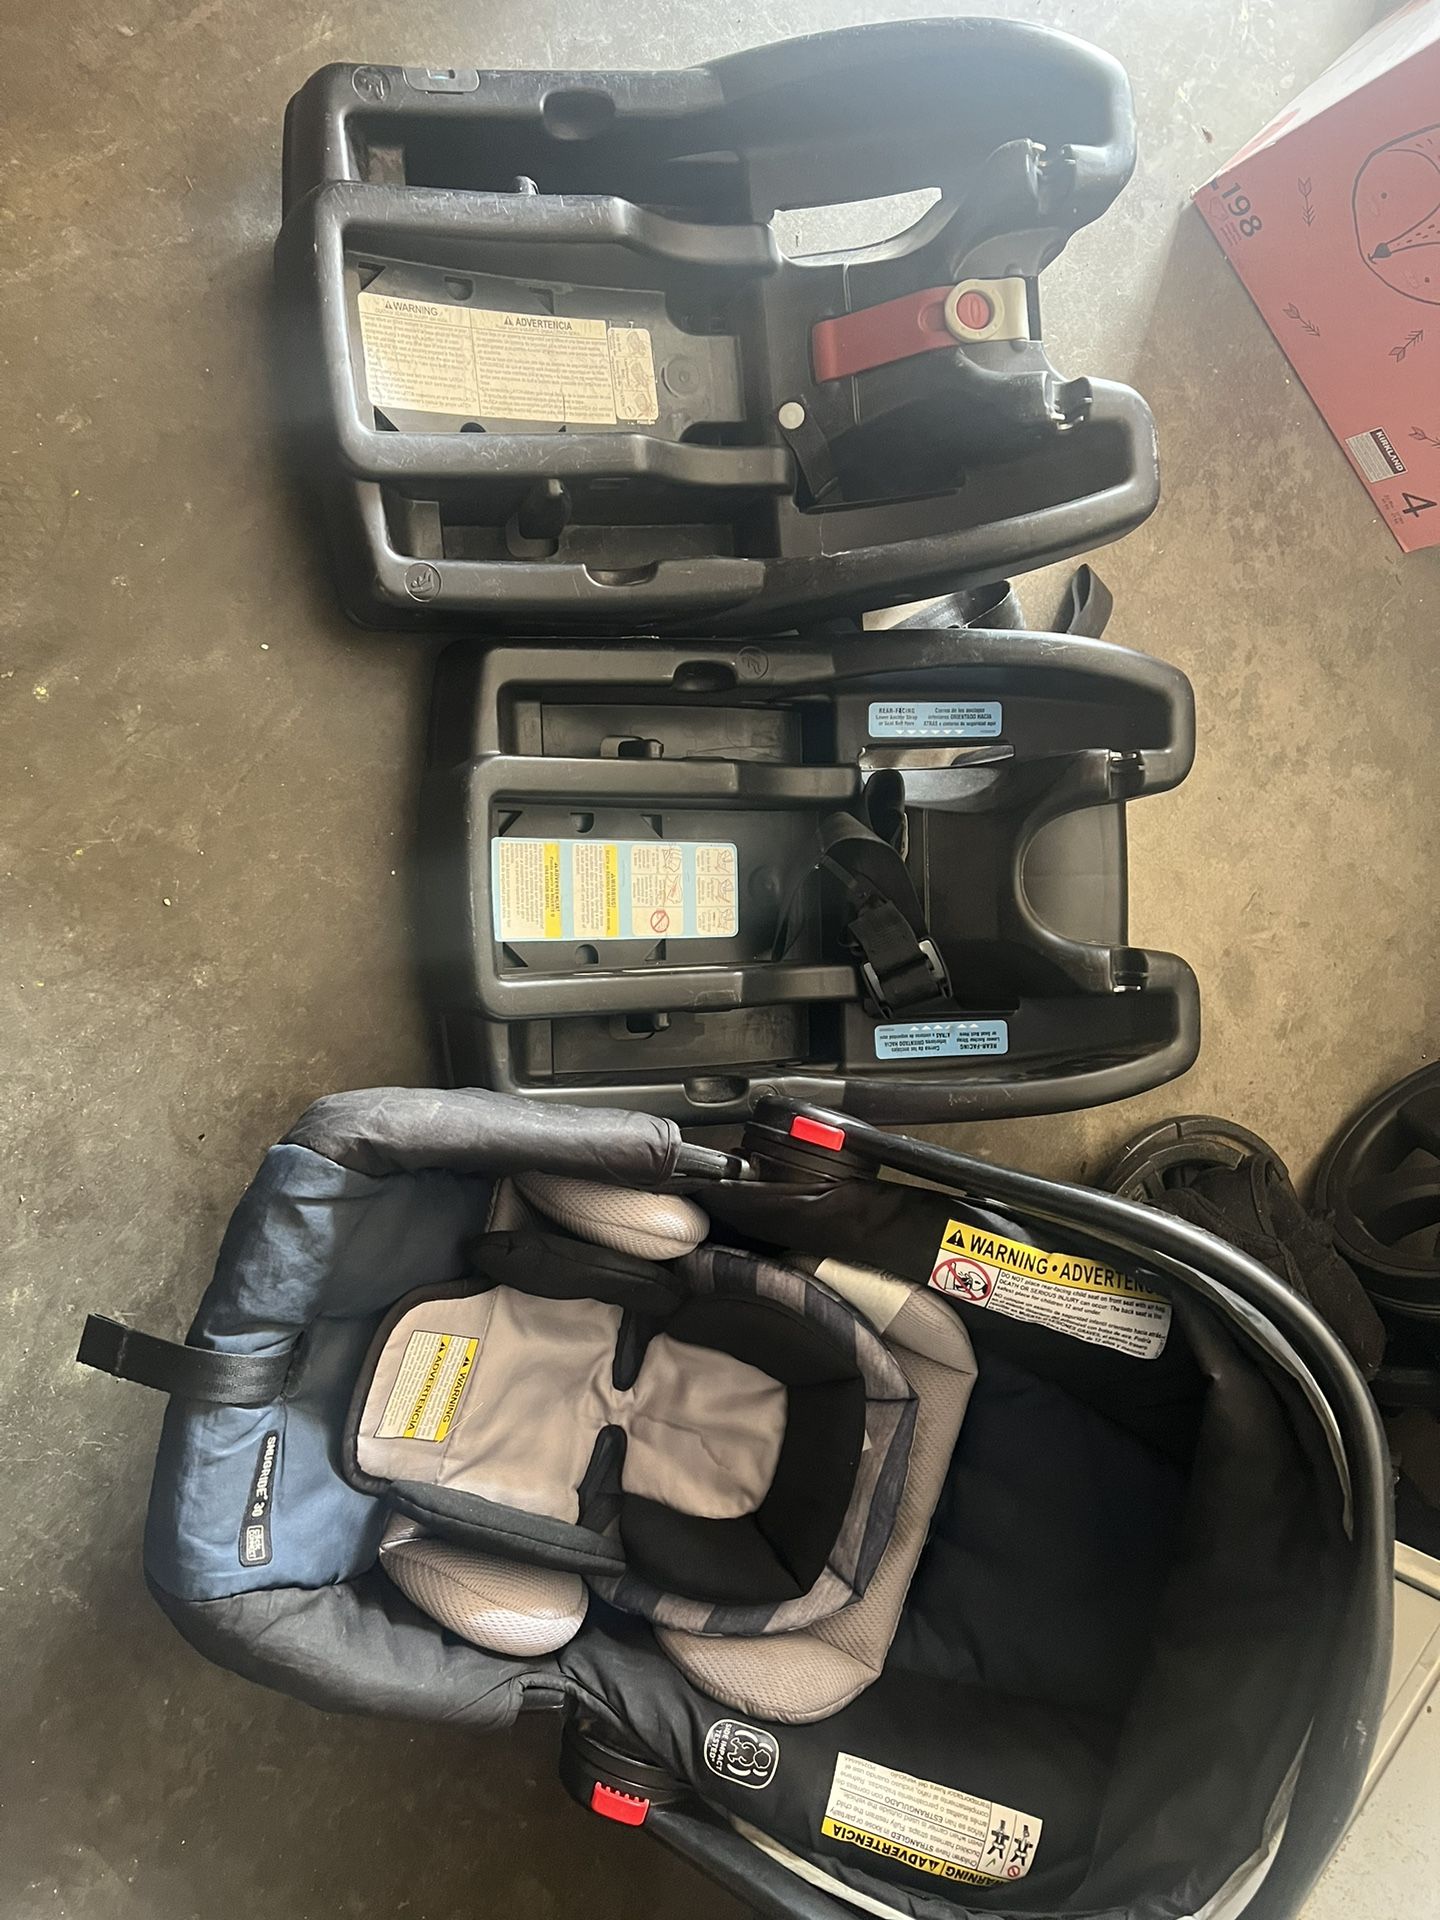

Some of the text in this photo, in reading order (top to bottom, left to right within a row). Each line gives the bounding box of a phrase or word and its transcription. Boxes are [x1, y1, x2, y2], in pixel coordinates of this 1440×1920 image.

[1221, 182, 1262, 237] 198
[394, 301, 439, 316] WARNING
[515, 316, 572, 331] ADVERTENCIA
[1375, 431, 1404, 472] KIRKLAND
[1401, 492, 1438, 518] 4
[970, 1234, 1048, 1274] WARNING
[996, 1285, 1014, 1293] safest
[1014, 1290, 1030, 1298] place
[1040, 1296, 1063, 1307] children
[1072, 1304, 1083, 1312] and
[998, 1278, 1019, 1288] DEATH
[1029, 1287, 1056, 1298] SERIOUS
[1057, 1293, 1079, 1303] INJURY
[1110, 1304, 1120, 1312] The
[1120, 1306, 1133, 1314] back
[1010, 1275, 1024, 1283] NOT
[1024, 1278, 1040, 1287] place
[1072, 1289, 1086, 1298] child
[1087, 1293, 1099, 1301] seat
[408, 1354, 442, 1431] ADVERTENCIA
[443, 1372, 466, 1423] WARNING
[716, 1723, 732, 1771] SIDE IMPACT
[836, 1799, 852, 1810] child
[883, 1796, 943, 1822] ESTRANGULADO
[833, 1824, 926, 1867] ADVERTENCIA
[890, 1831, 934, 1852] STRANGLED
[935, 1847, 950, 1857] have
[951, 1853, 977, 1867] Children
